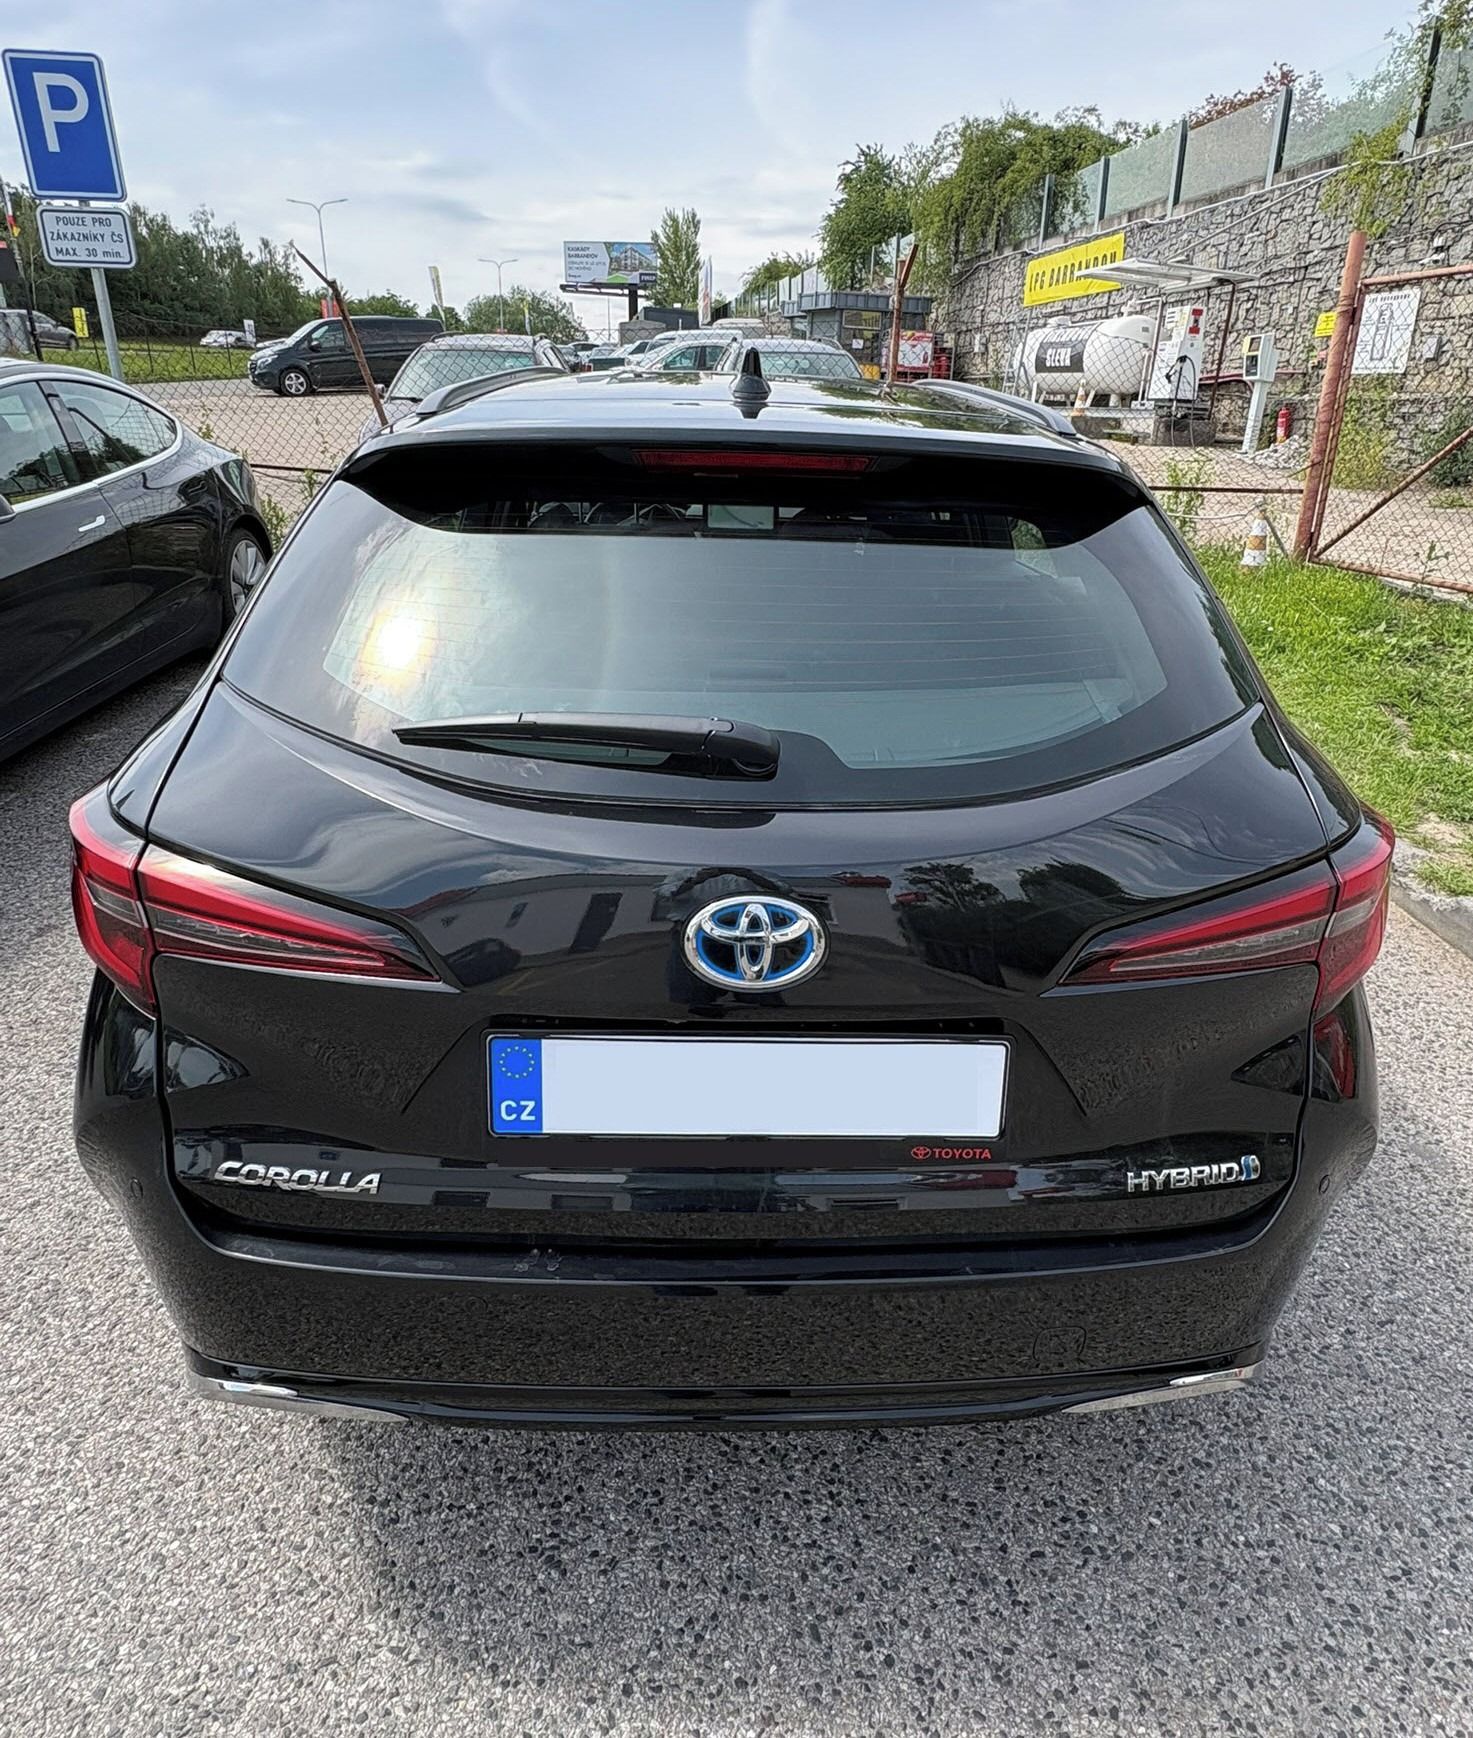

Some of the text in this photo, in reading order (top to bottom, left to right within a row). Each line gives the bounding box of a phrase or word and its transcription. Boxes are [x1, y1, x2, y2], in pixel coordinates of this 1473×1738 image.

[32, 72, 89, 152] P
[55, 216, 112, 227] POUZE PRO
[49, 229, 124, 243] ZÁKAZNÍKY ČS
[55, 247, 125, 258] MAX. 30 min.
[1029, 270, 1046, 292] LPG
[500, 1100, 536, 1120] CZ
[933, 1148, 992, 1159] TOYOTA
[214, 1160, 382, 1195] COROLLA
[1127, 1162, 1240, 1193] HYBRID
